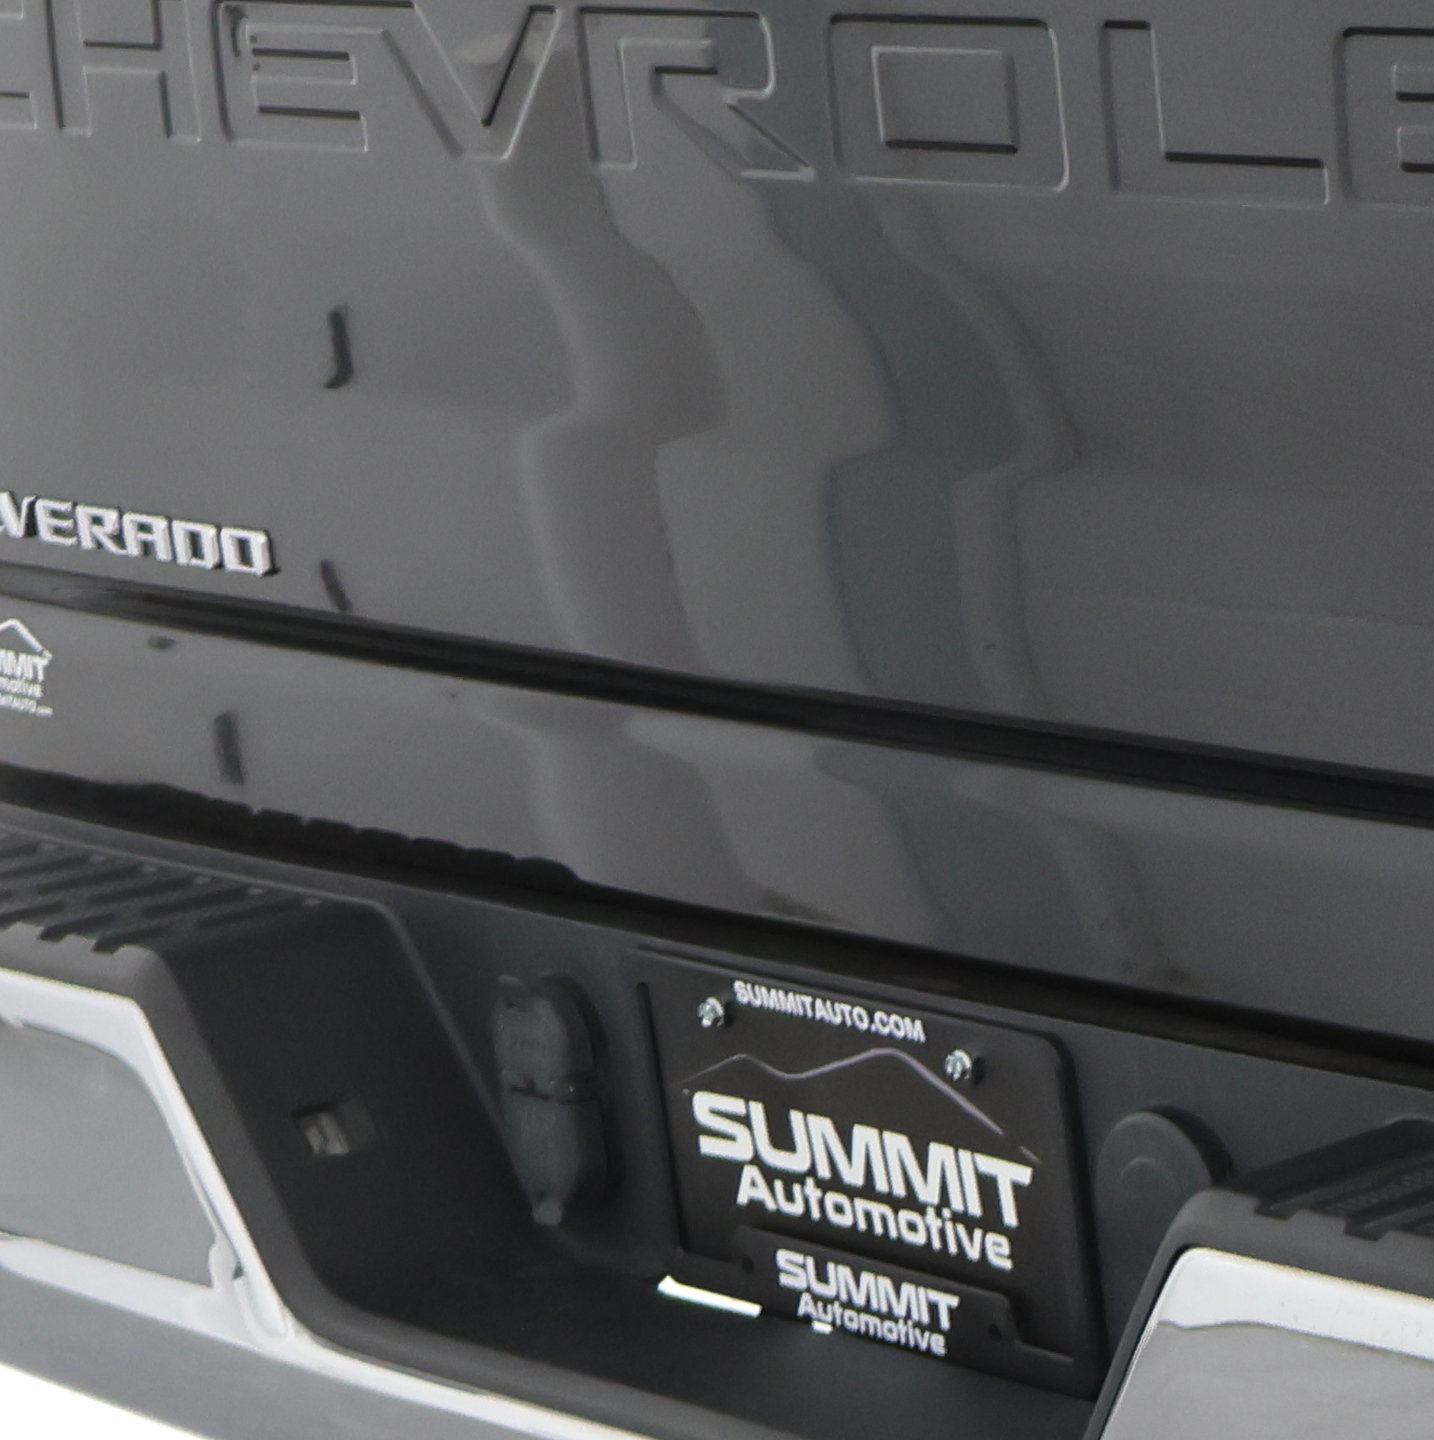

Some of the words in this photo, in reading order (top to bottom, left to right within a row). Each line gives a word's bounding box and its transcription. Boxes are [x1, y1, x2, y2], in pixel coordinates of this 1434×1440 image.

[0, 491, 272, 576] VERADO
[733, 979, 926, 1044] SUMMITAUTO.COM
[692, 1090, 1034, 1228] SUMMIT
[736, 1163, 1014, 1271] Automotive
[775, 1248, 960, 1330] SUMMIT
[797, 1292, 946, 1356] Automotive
